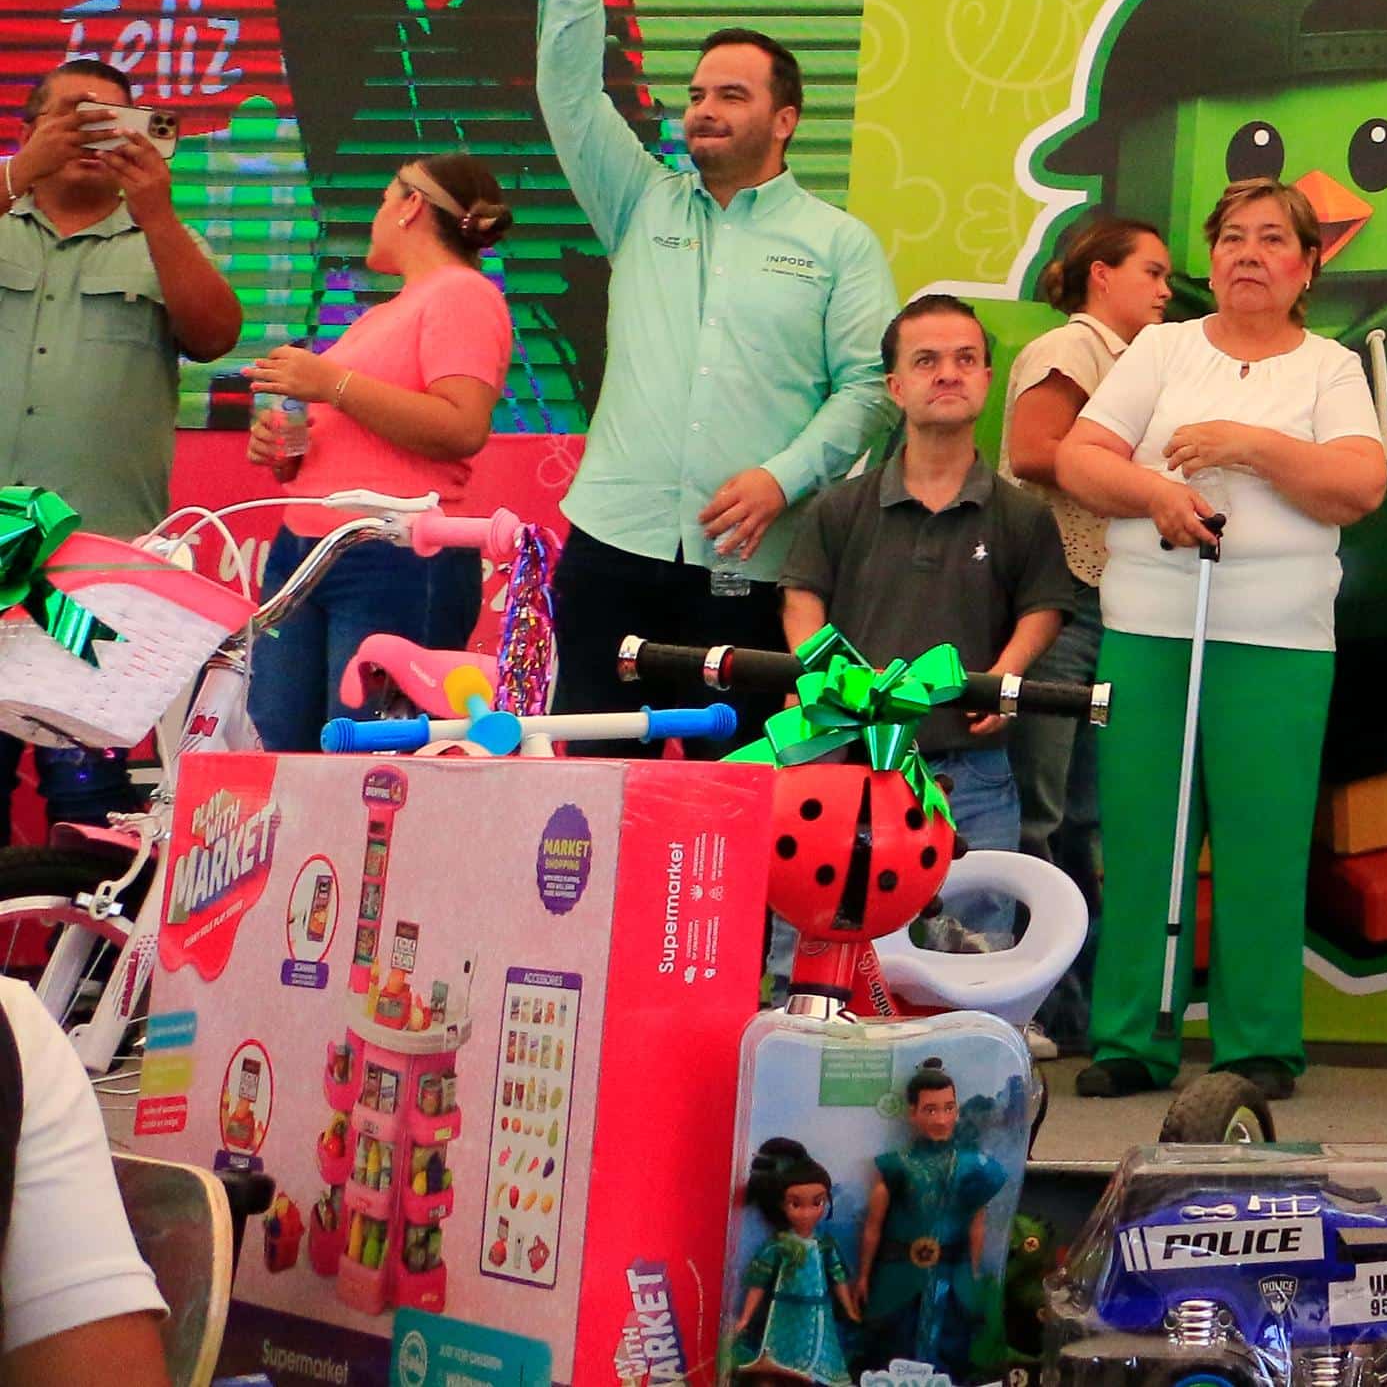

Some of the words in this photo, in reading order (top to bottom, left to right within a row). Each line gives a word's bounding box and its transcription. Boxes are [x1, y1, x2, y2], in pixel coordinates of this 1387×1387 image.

[173, 805, 279, 913] MARKET
[544, 839, 590, 857] MARKET
[658, 841, 684, 974] Supermarket
[1163, 1227, 1302, 1260] POLICE
[1261, 1280, 1295, 1295] POLICE
[261, 1338, 350, 1386] Supermarket
[622, 1327, 648, 1377] WITH
